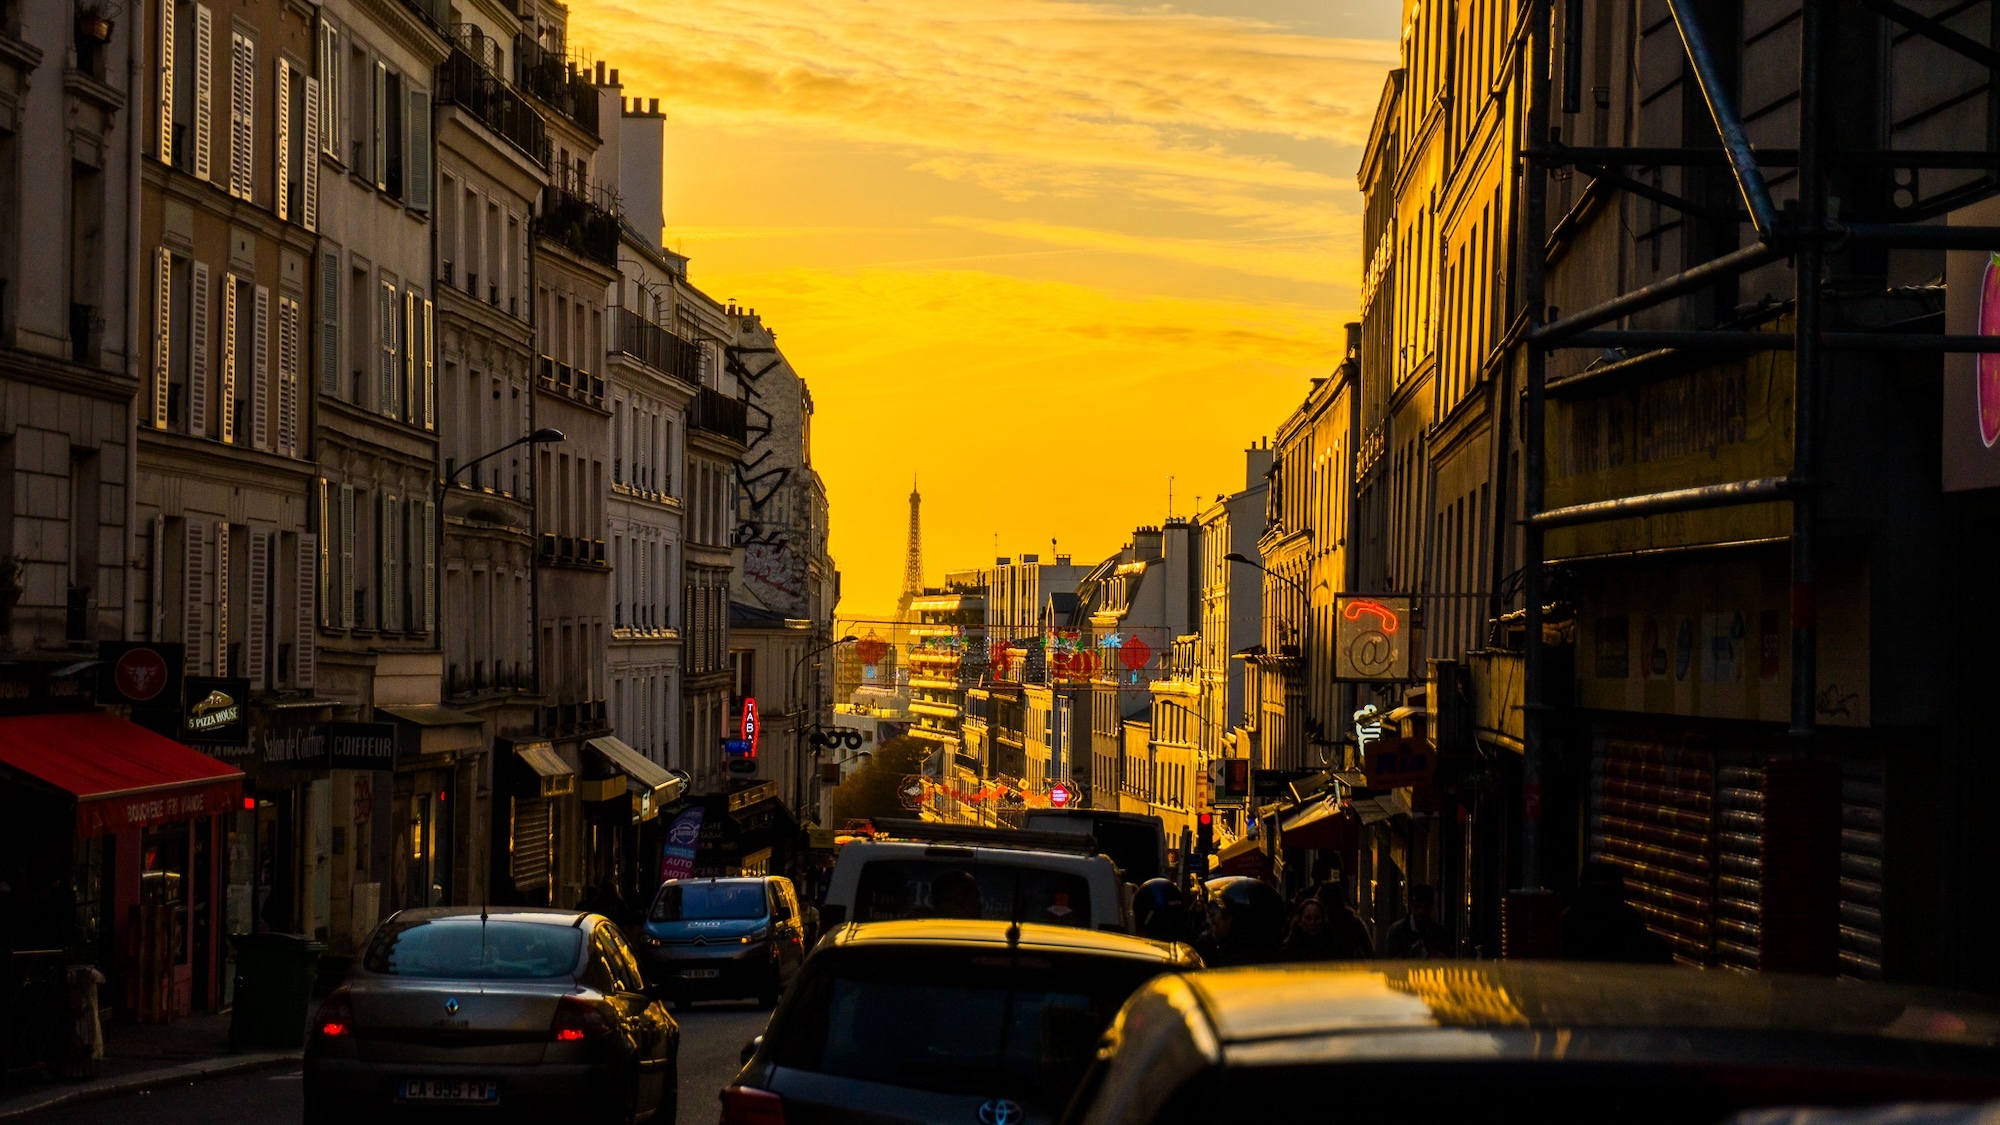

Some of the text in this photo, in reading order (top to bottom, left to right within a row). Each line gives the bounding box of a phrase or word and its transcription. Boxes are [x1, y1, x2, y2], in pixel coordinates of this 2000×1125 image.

[196, 714, 216, 728] PIZZA
[215, 706, 238, 723] HOUSE
[263, 728, 286, 762] Salon
[286, 726, 296, 760] de
[333, 735, 392, 758] COIFFEUR
[126, 799, 164, 823] BOUCHERIE
[666, 857, 693, 869] AUTO
